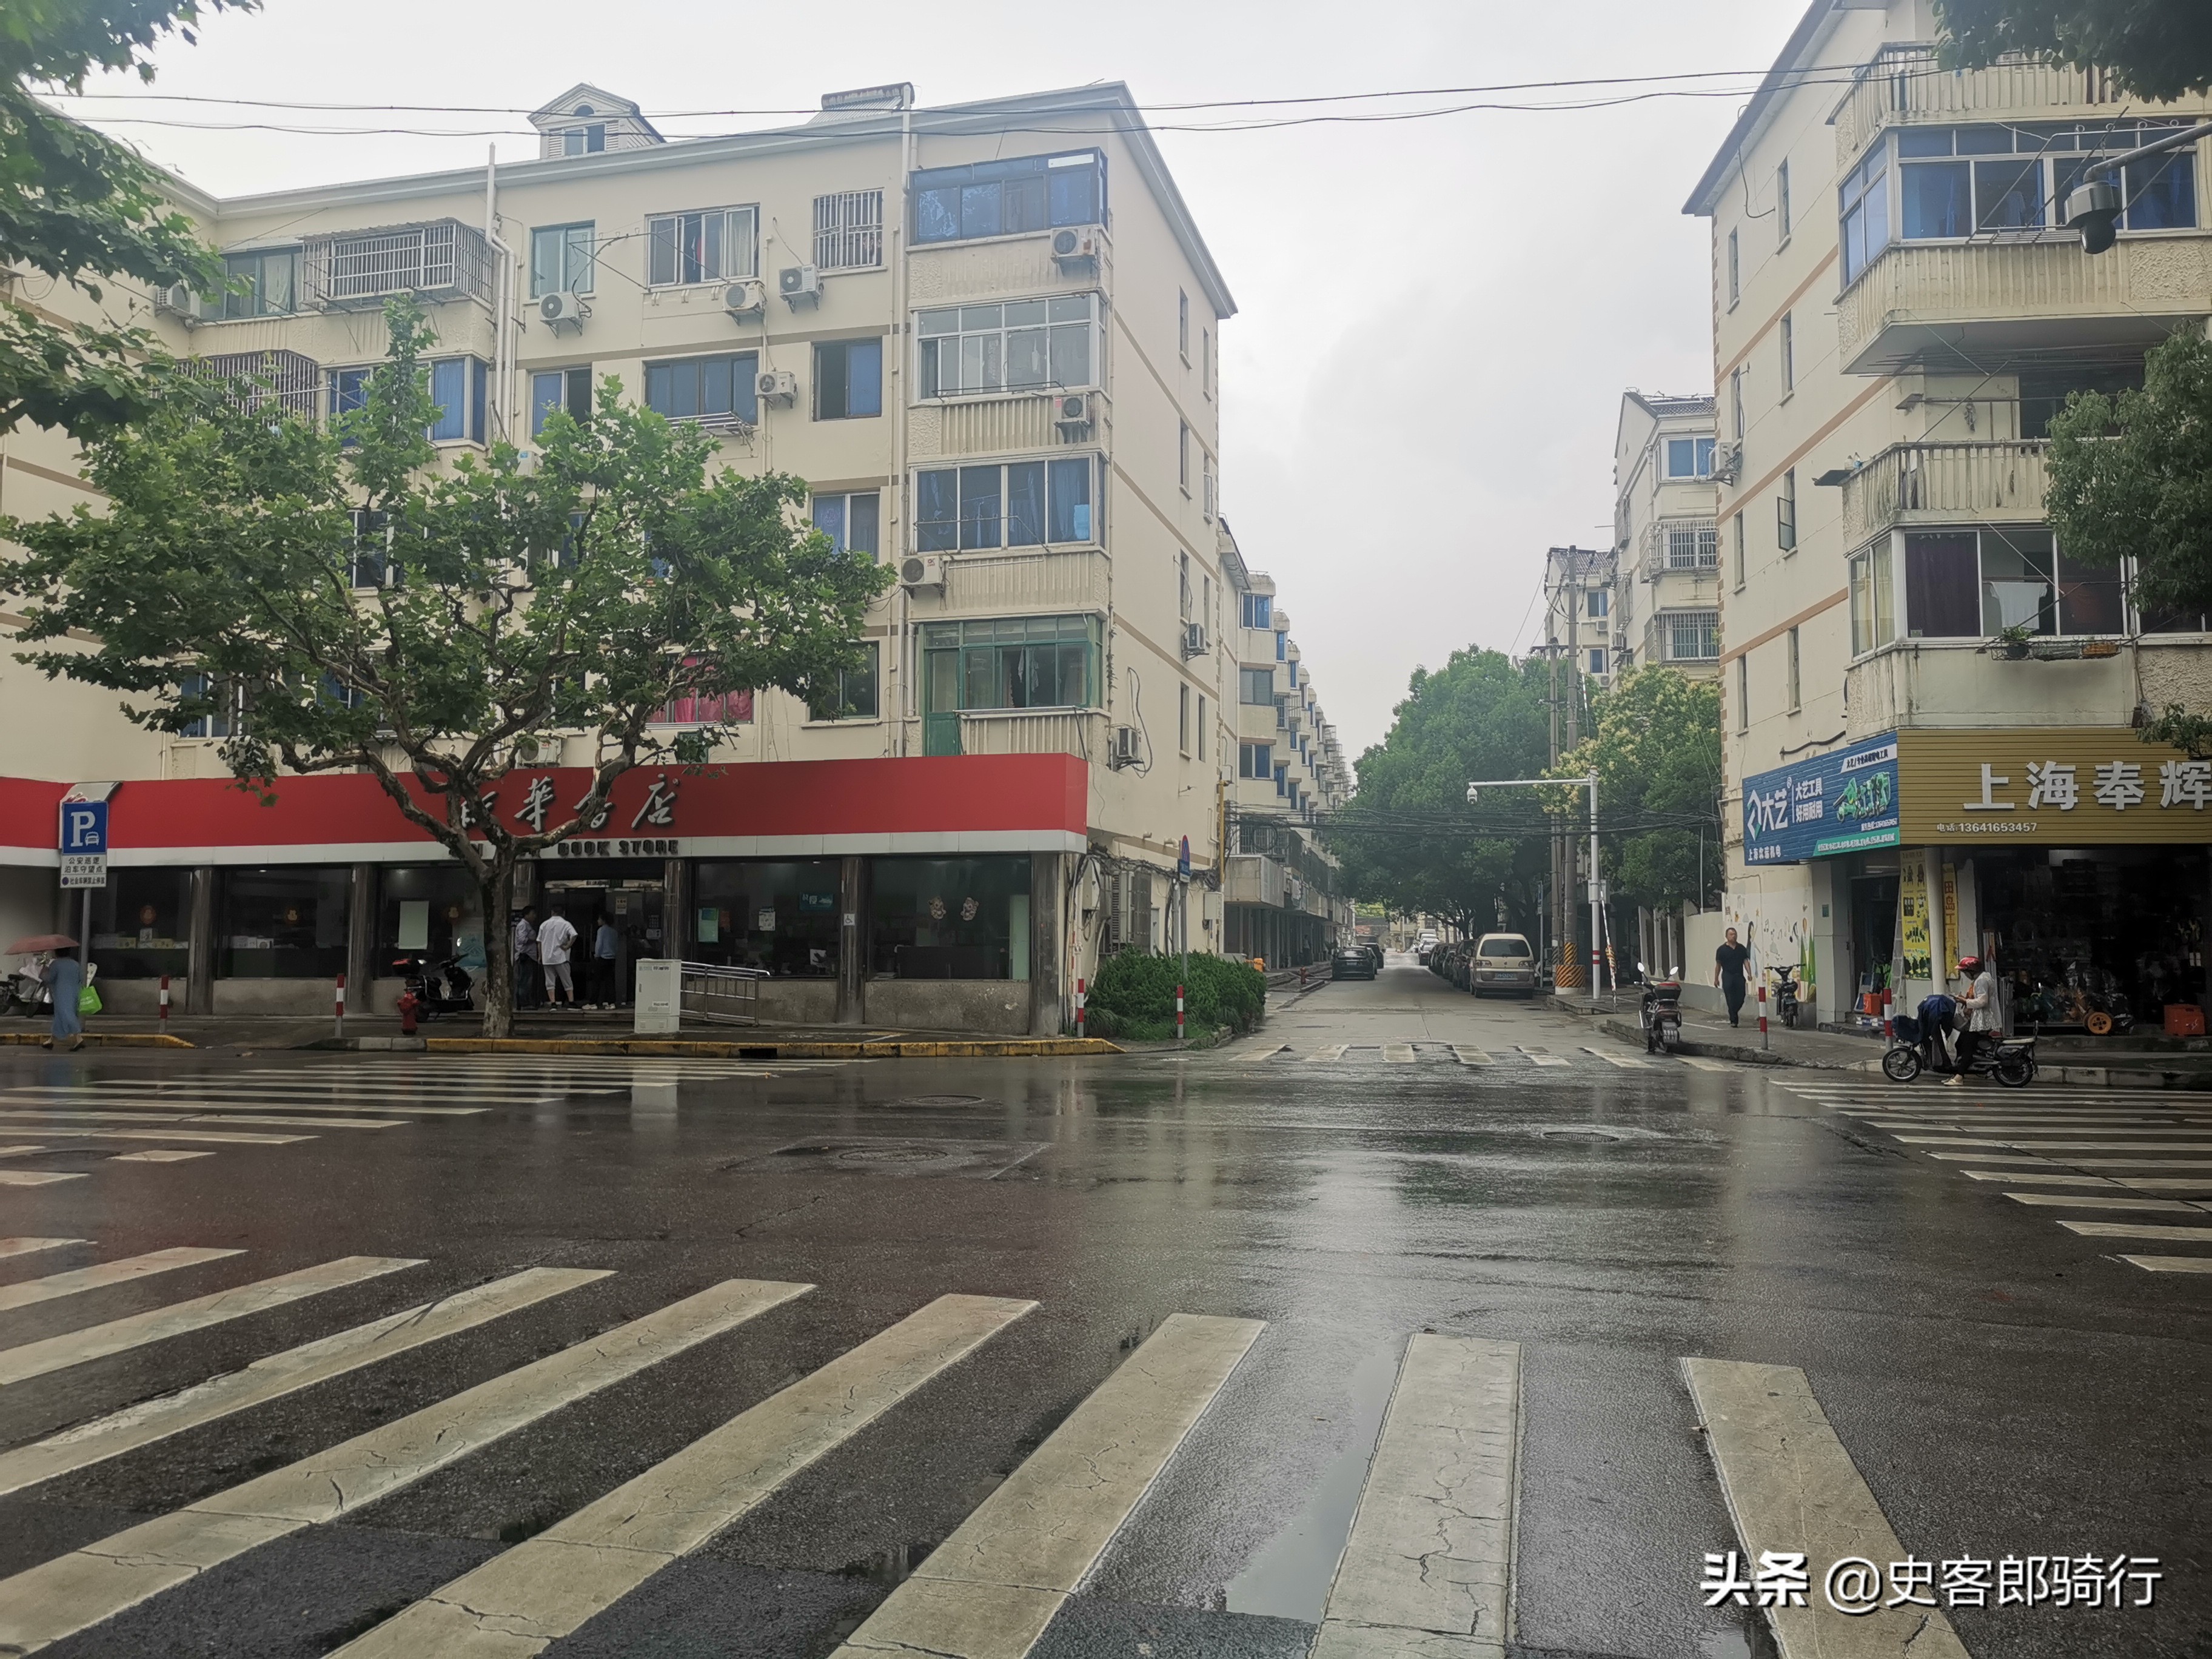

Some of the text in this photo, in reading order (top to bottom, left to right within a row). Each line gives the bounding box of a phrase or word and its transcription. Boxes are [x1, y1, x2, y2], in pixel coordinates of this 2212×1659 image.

[1795, 777, 1823, 801] 大艺工具
[1963, 760, 2212, 811] 上海奉辉
[1762, 788, 1788, 832] 大艺
[70, 811, 96, 847] P
[557, 840, 611, 857] BOOK
[618, 839, 679, 856] STORE
